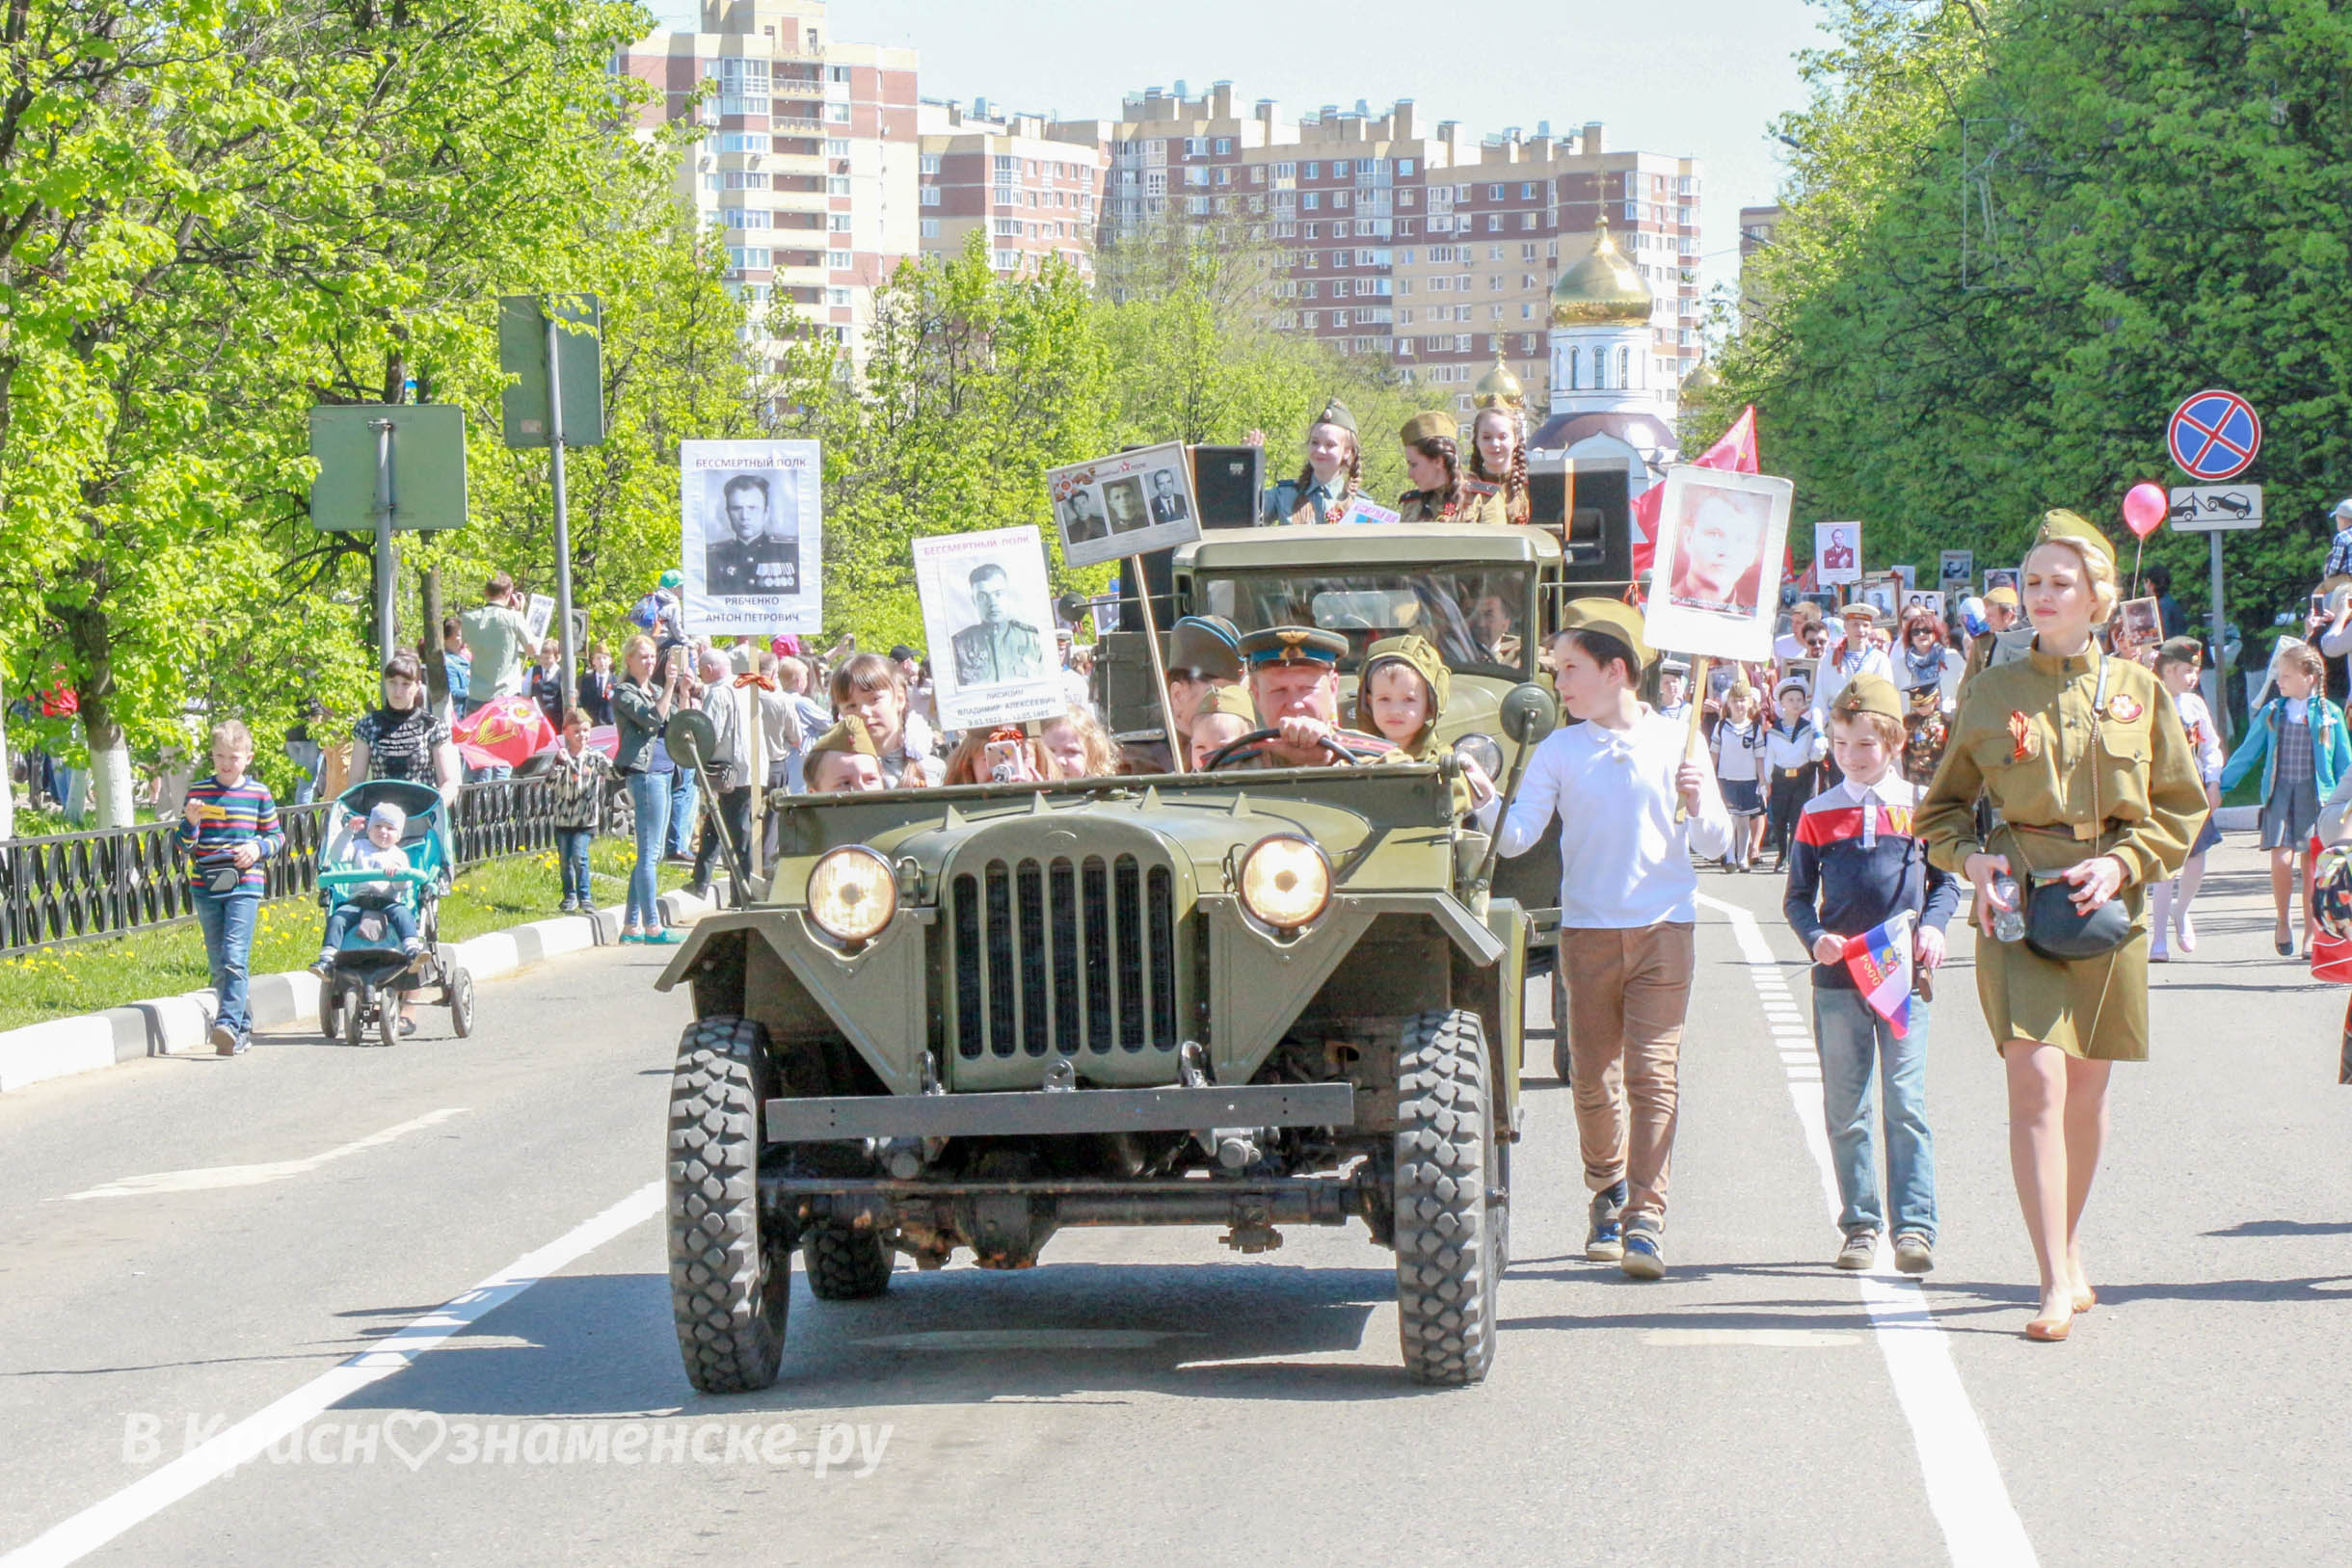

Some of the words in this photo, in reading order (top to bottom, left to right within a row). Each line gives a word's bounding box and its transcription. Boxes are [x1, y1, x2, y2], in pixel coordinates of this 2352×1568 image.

[695, 456, 774, 468] БЕССМЕРТНЫЙ
[776, 458, 807, 468] ПОЛК
[724, 596, 780, 606] РЯБЧЕНКО
[706, 613, 742, 623] АНТОН
[744, 613, 799, 623] ПЕТРОВИЧ
[957, 704, 1002, 716] ВЛАДИМИР
[1004, 695, 1056, 709] АЛЕКСЕЕВИЧ
